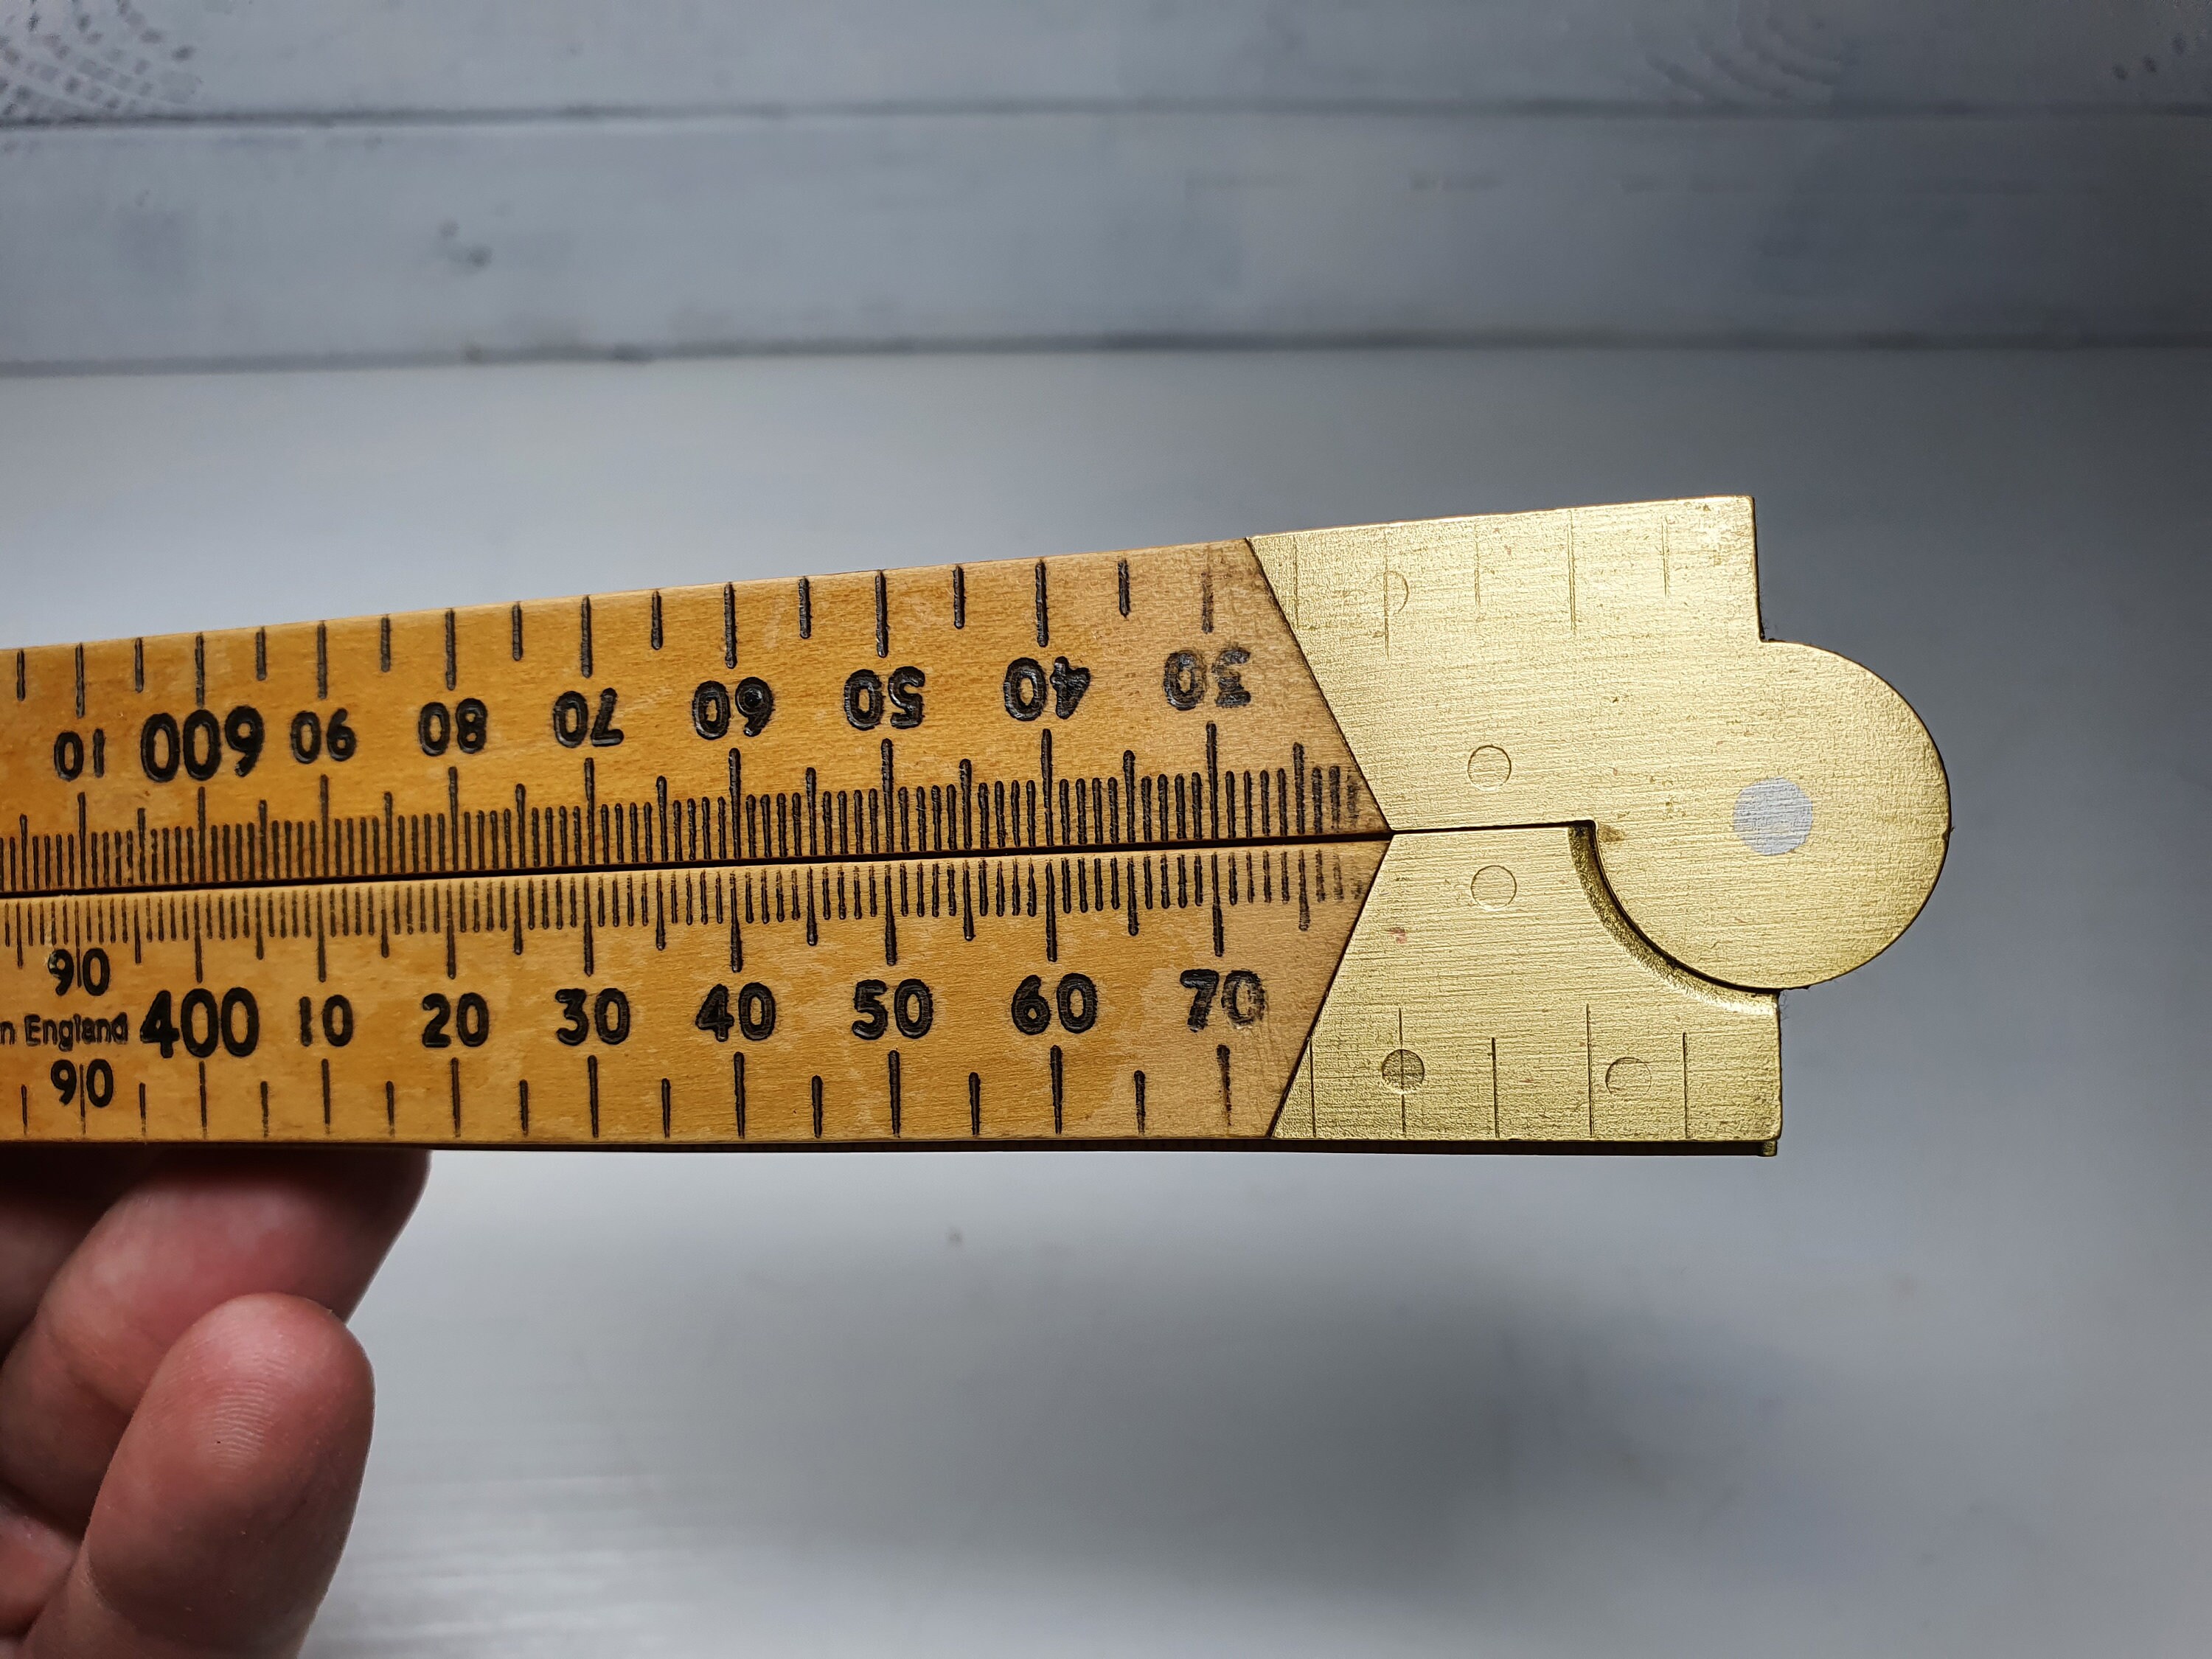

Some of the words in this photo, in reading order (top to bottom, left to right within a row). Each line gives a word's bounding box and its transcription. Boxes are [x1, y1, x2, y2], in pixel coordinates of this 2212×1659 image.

[843, 665, 925, 730] 50
[1003, 656, 1091, 721] 40
[1164, 644, 1251, 710] 30
[291, 708, 358, 764] 90
[417, 698, 488, 756] 80
[552, 687, 625, 748] 70
[692, 677, 773, 740] 60
[54, 728, 105, 781] 10
[140, 705, 265, 781] 600
[46, 948, 111, 996] 90
[24, 1013, 128, 1052] England
[139, 987, 260, 1058] 400
[299, 994, 354, 1047] 10
[421, 992, 490, 1048] 20
[554, 987, 630, 1046] 30
[695, 982, 776, 1042] 40
[851, 978, 933, 1040] 50
[1011, 972, 1097, 1034] 60
[1180, 968, 1265, 1032] 70
[50, 1059, 114, 1107] 90
